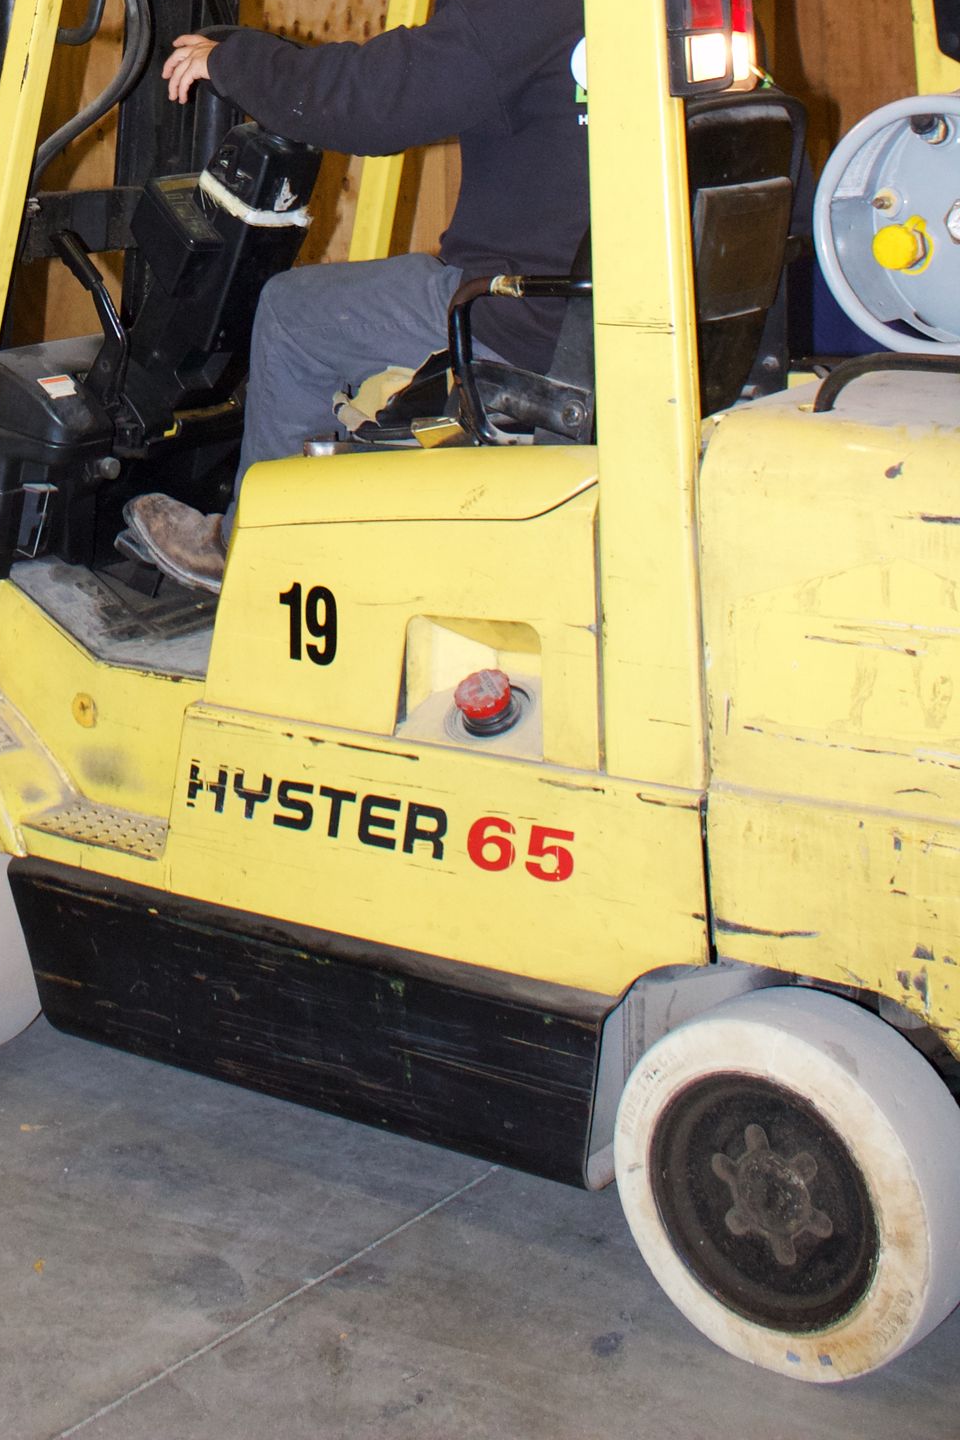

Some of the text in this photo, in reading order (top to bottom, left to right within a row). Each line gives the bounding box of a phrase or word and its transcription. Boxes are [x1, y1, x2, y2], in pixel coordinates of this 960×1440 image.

[279, 582, 337, 666] 19
[186, 758, 575, 882] HYSTER 65
